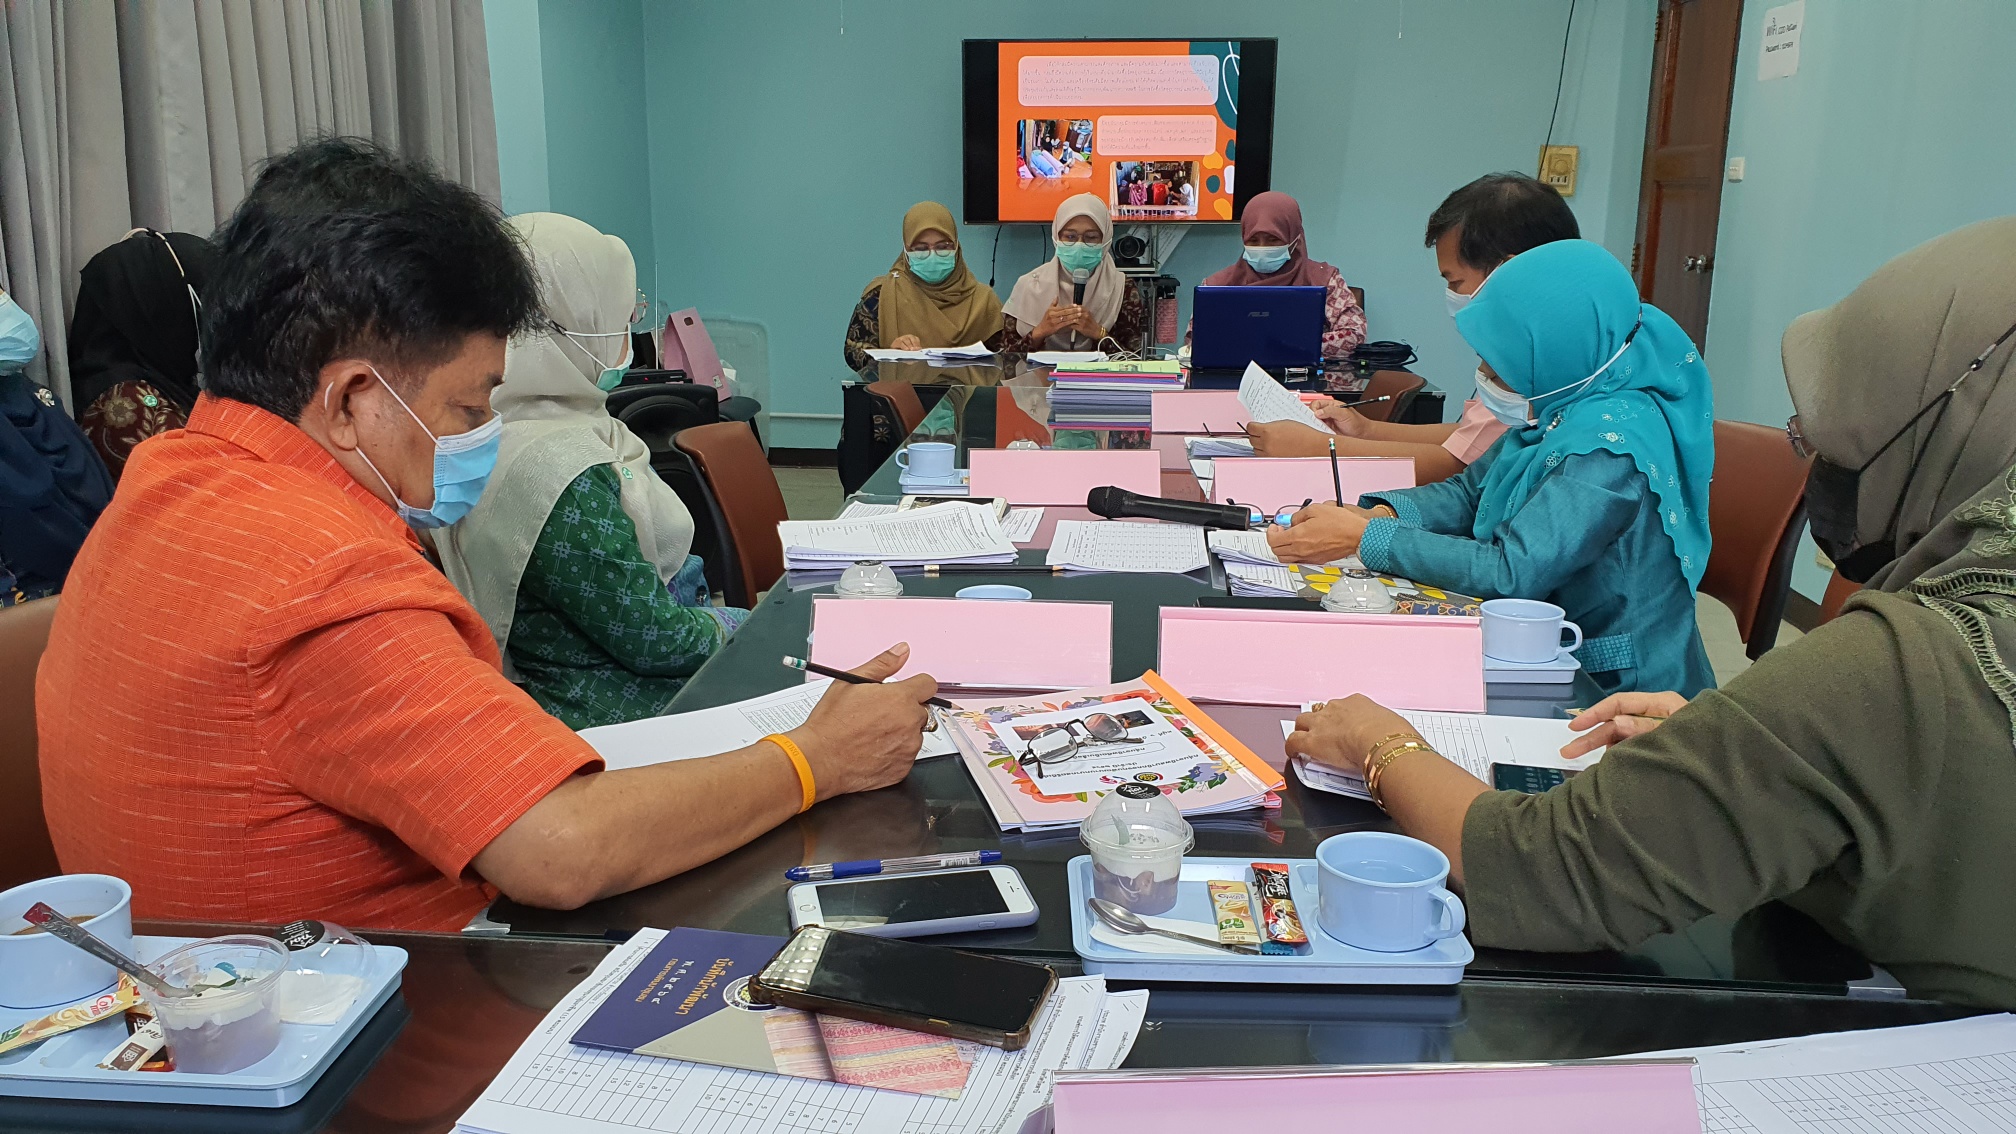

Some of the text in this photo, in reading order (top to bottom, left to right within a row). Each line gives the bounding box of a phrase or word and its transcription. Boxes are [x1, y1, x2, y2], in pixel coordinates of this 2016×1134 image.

[635, 958, 678, 1002] กรมการพัฒนาชุมชน
[674, 958, 734, 1016] บันทึกนักพัฒนา
